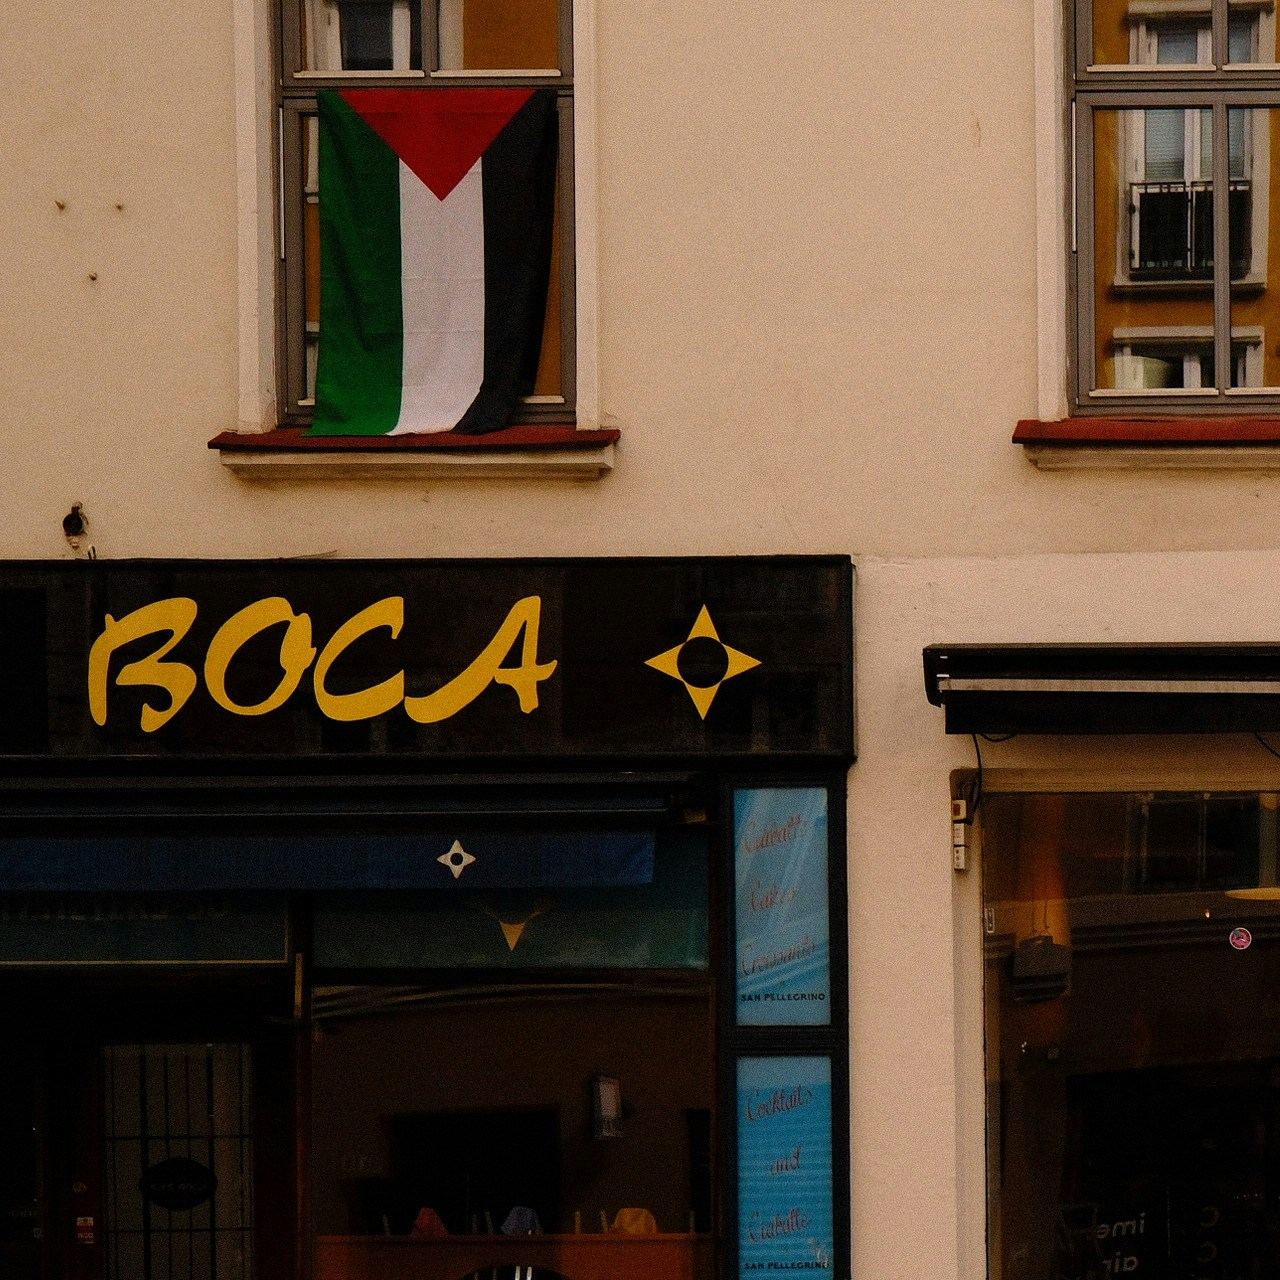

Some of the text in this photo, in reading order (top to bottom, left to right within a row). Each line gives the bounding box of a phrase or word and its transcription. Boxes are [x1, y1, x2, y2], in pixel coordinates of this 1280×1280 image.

[89, 595, 557, 733] BOCA
[764, 993, 826, 1001] PELLEGRINO
[746, 1084, 812, 1122] Cocktails
[769, 1145, 802, 1176] and
